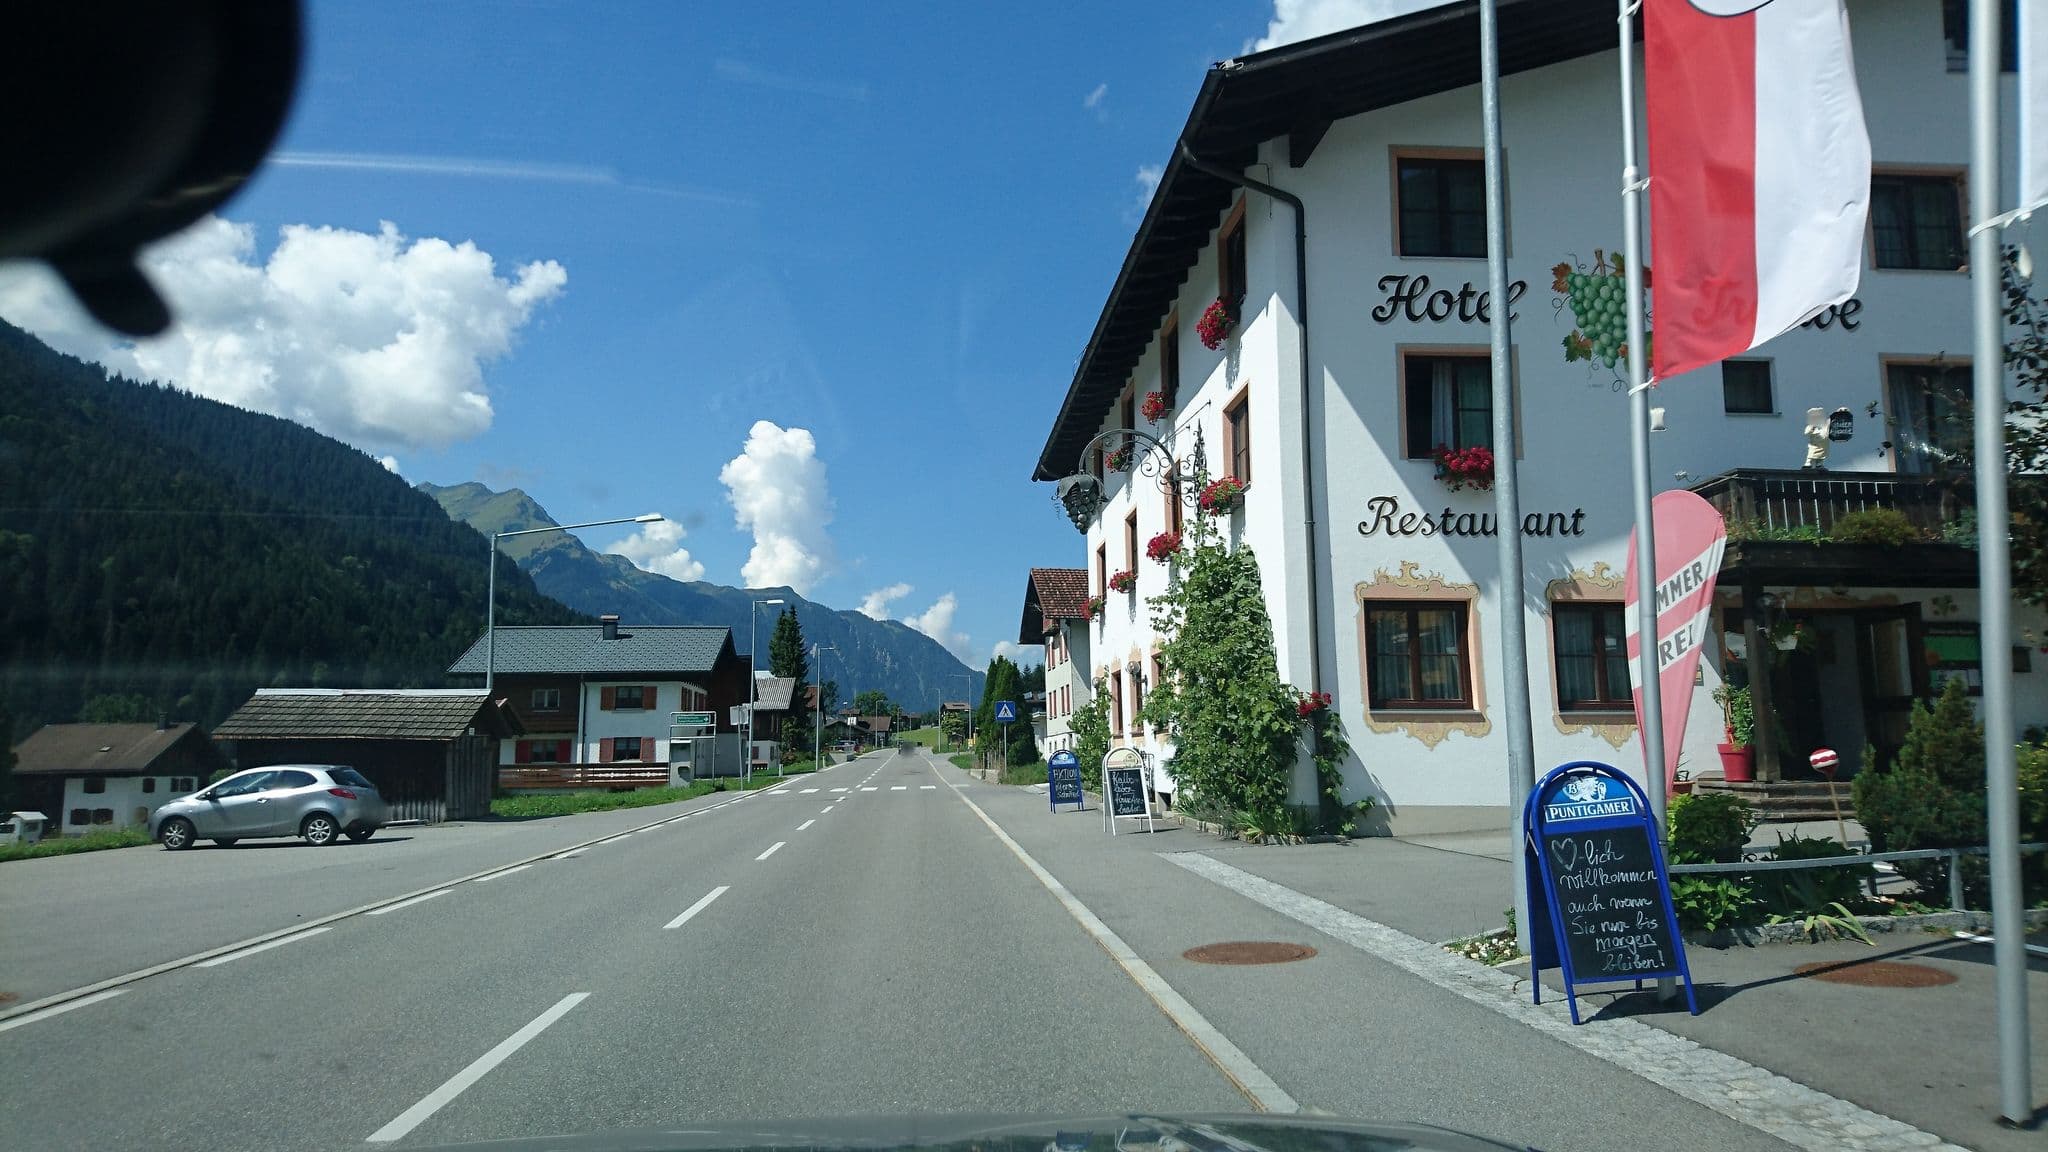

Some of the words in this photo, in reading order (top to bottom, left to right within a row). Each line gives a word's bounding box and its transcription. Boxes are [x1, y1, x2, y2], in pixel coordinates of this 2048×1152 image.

[1371, 274, 1528, 323] Hotel
[1357, 495, 1586, 536] Restauant
[1658, 623, 1695, 667] REI
[1549, 801, 1630, 820] PUNTIGAMER
[1567, 893, 1606, 914] auch
[1571, 915, 1597, 935] Sie
[1600, 919, 1630, 932] nur
[1636, 910, 1659, 930] bis
[1595, 932, 1657, 955] morgen
